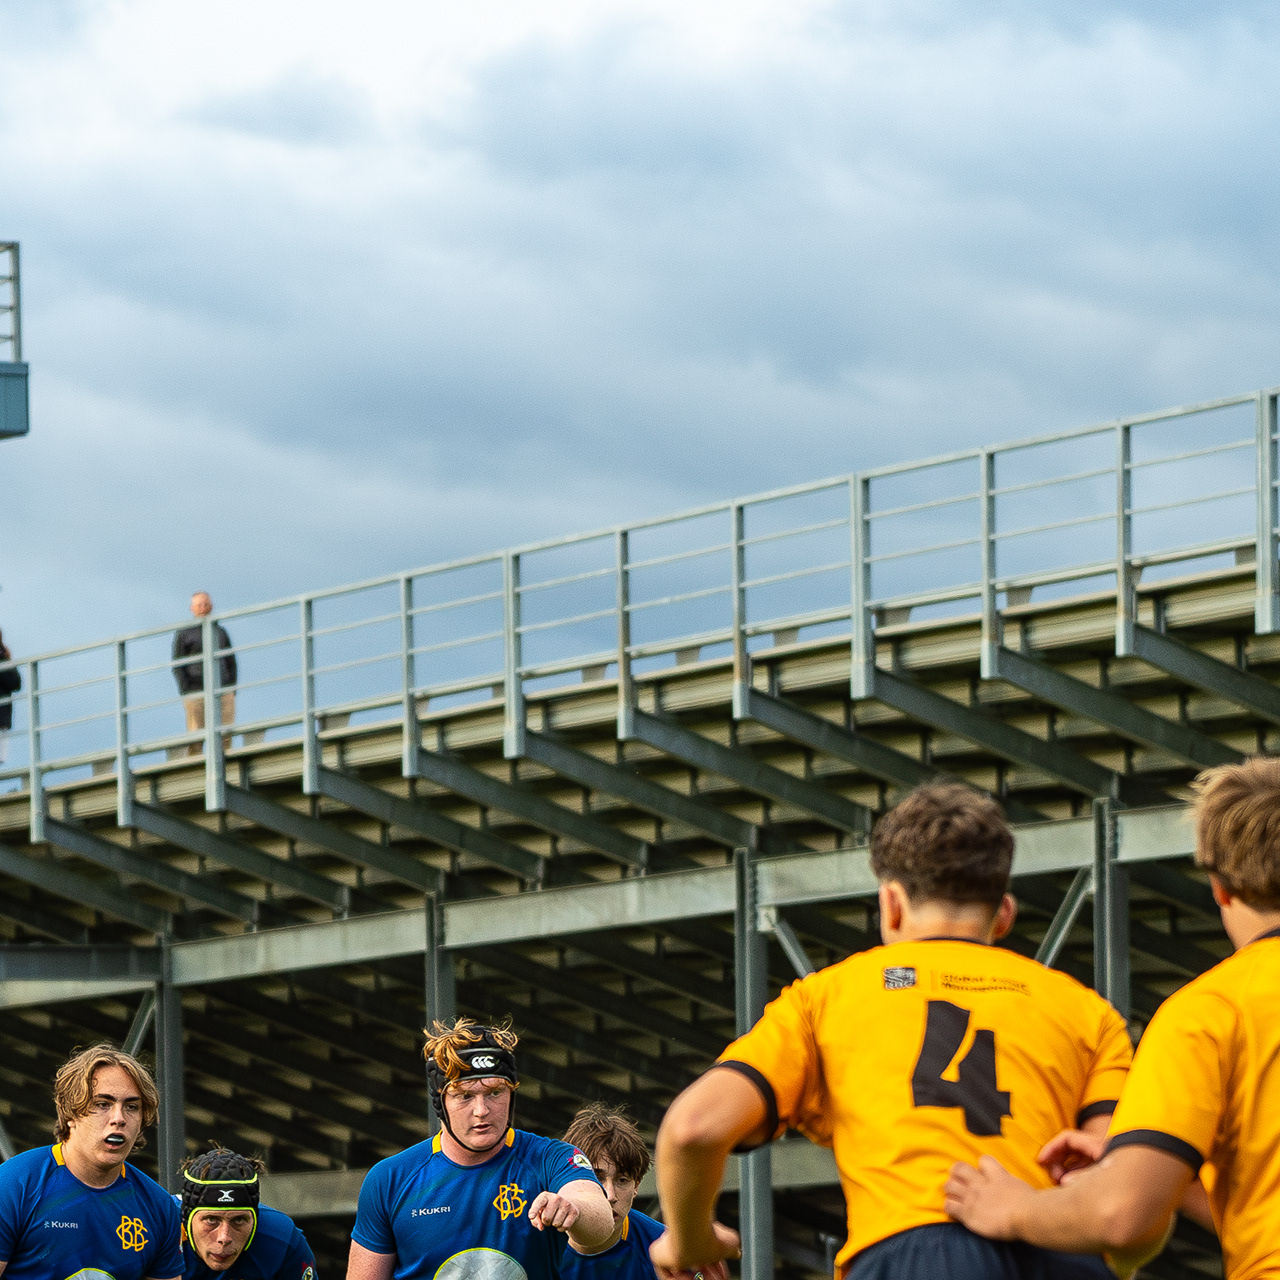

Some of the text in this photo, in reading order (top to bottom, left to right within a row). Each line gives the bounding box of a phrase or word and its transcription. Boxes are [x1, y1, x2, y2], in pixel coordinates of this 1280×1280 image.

[912, 1000, 1012, 1136] 4
[419, 1206, 451, 1216] KUKRI
[51, 1221, 78, 1229] KUKRI
